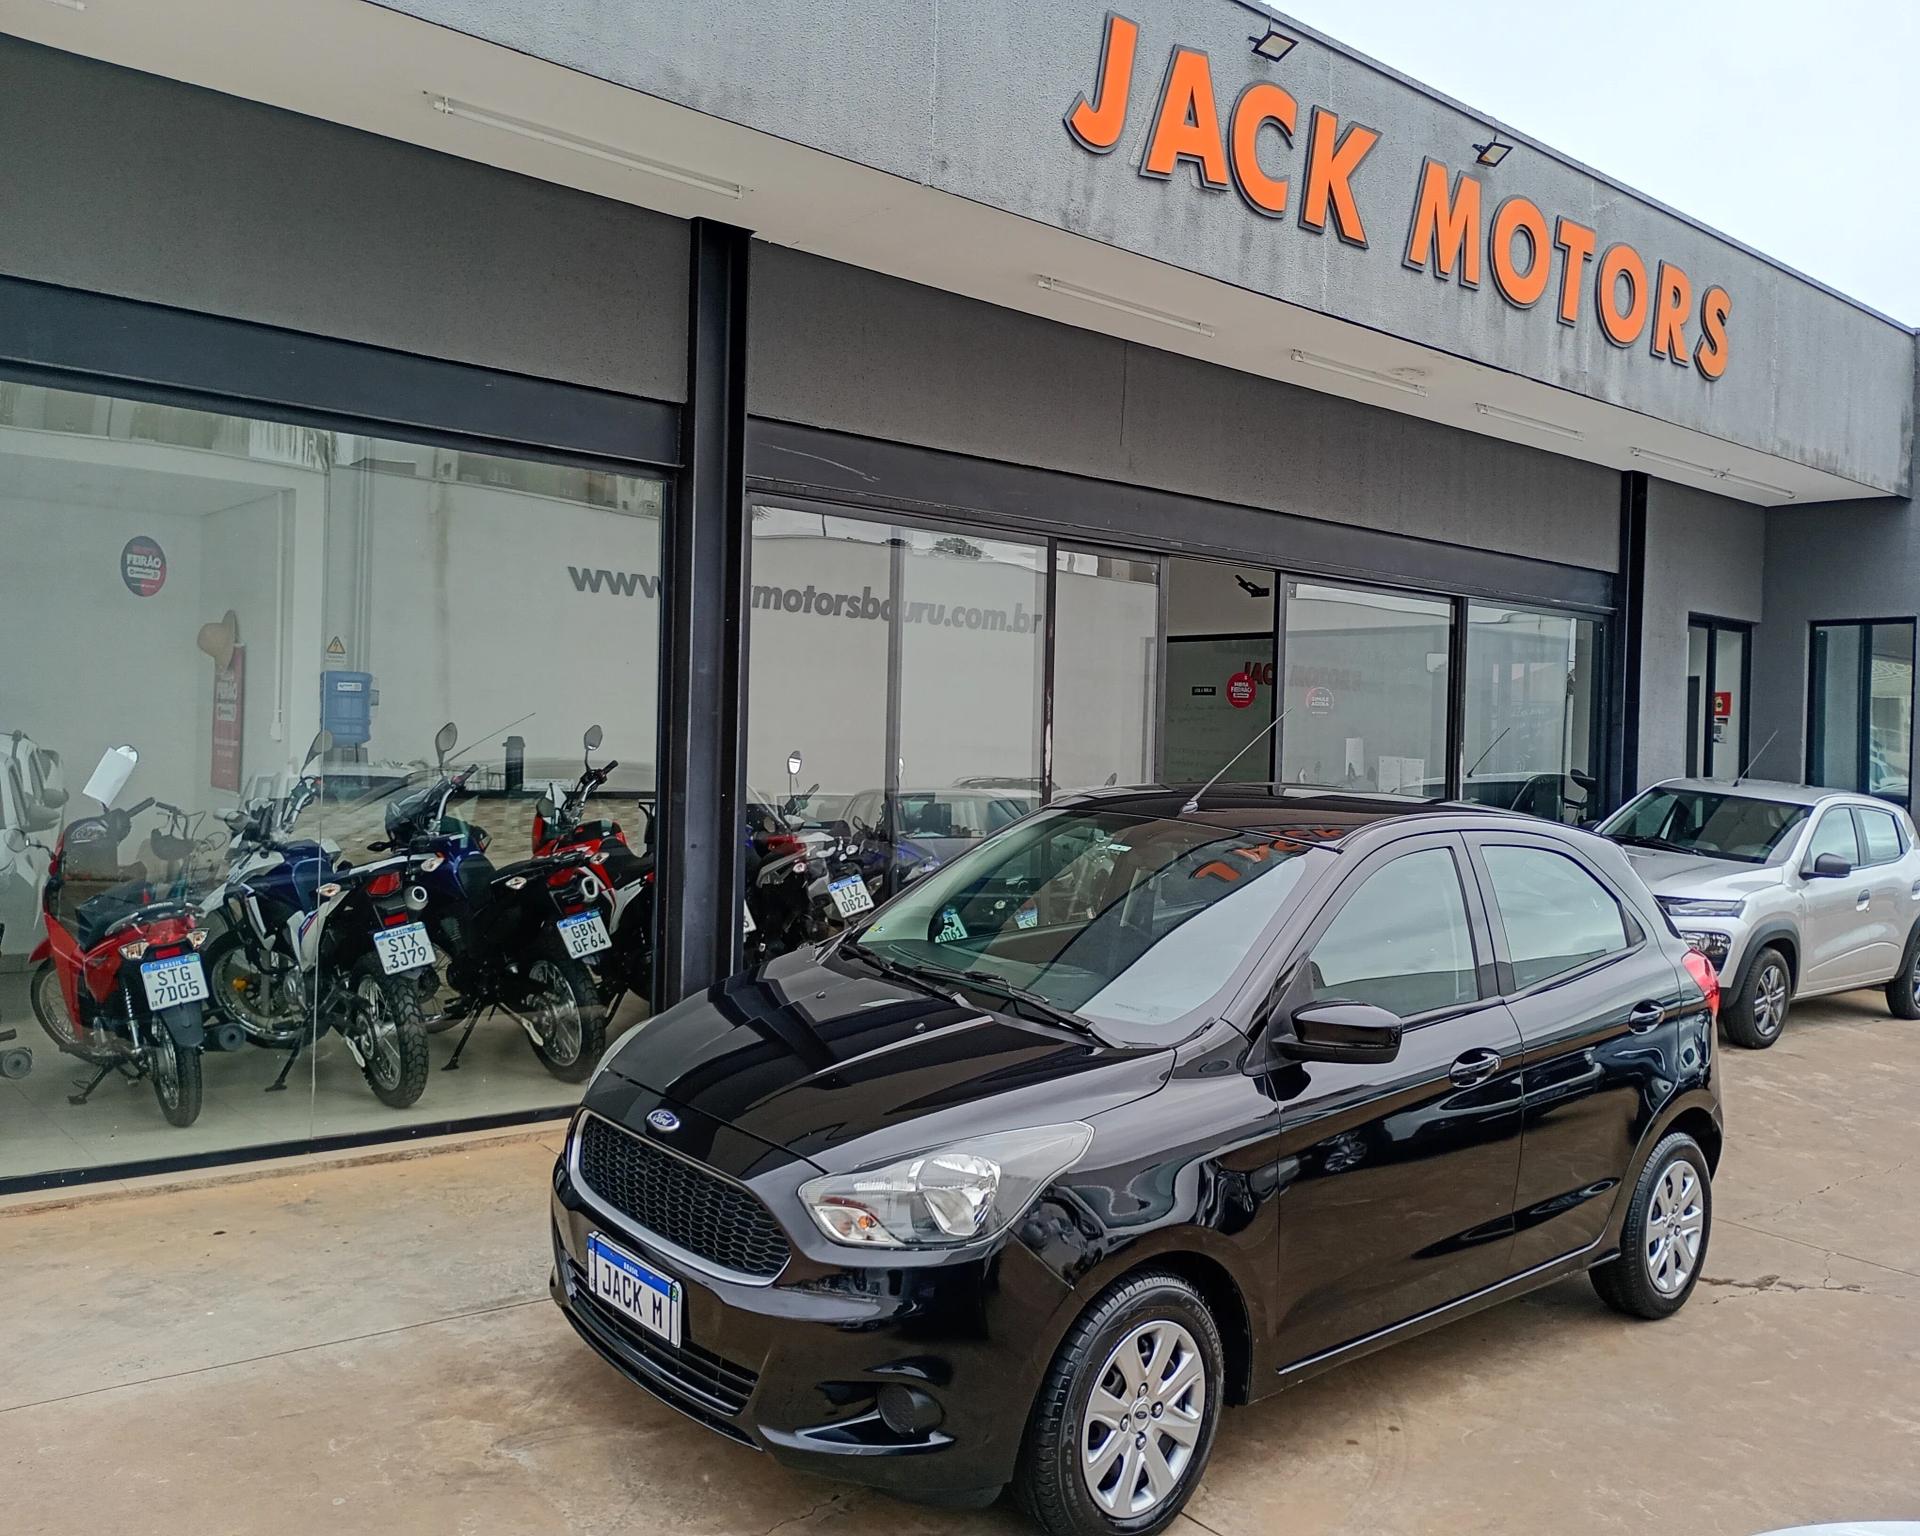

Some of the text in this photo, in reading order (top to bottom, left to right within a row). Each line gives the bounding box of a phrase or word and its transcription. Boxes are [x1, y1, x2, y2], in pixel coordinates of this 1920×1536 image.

[1068, 14, 1730, 379] JACK MOTORS
[840, 884, 861, 900] TIZ
[571, 920, 598, 939] GBN
[388, 933, 420, 952] STX
[388, 946, 427, 969] 3J79
[157, 966, 191, 986] STG
[154, 980, 200, 1005] 7D05
[652, 1112, 673, 1126] Ford
[602, 1263, 663, 1329] JACK M
